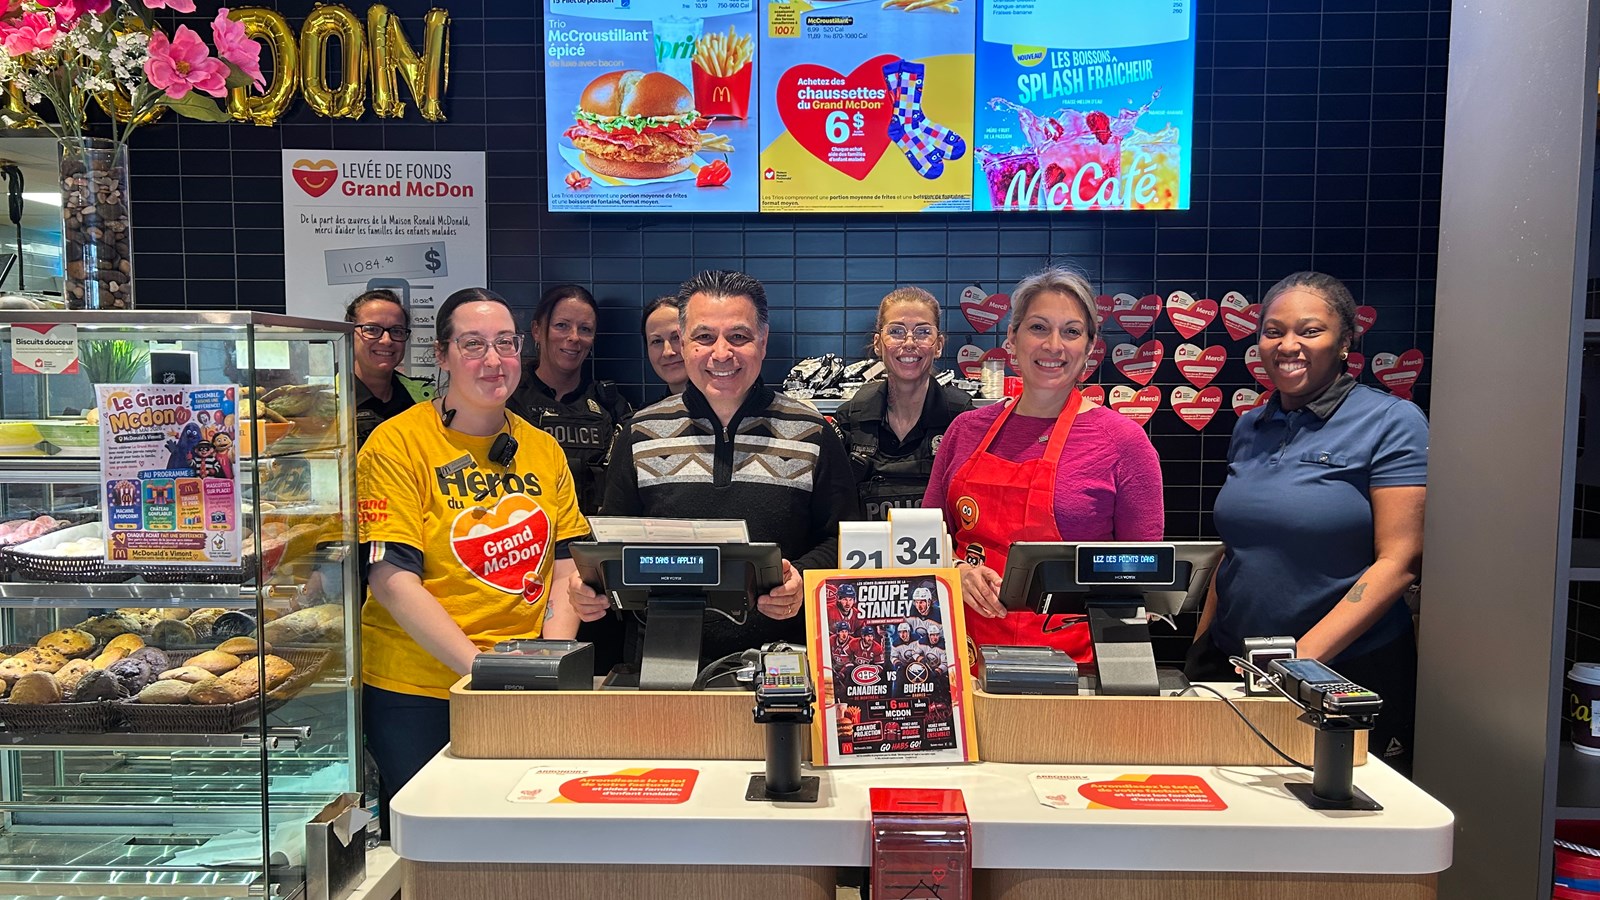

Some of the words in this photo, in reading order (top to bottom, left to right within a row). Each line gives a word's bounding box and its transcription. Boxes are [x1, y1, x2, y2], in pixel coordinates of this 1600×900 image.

[548, 20, 566, 28] Trio
[775, 26, 789, 34] 100
[548, 29, 648, 42] McCroustillant
[548, 43, 585, 59] épicé
[1017, 52, 1042, 61] NOUVEAU!
[1051, 52, 1071, 69] LES
[1073, 50, 1111, 66] BOISSONS
[1017, 65, 1084, 104] SPLASH
[1088, 56, 1153, 91] FRAÎCHEUR
[798, 87, 885, 99] chaussettes
[798, 100, 810, 109] du
[812, 100, 843, 109] Grand
[846, 100, 881, 109] McDon
[825, 110, 850, 144] 6
[853, 111, 864, 130] $
[343, 160, 381, 178] LEVÉE
[385, 164, 403, 178] DE
[407, 164, 452, 179] FONDS
[342, 180, 401, 197] Grand
[406, 182, 474, 197] McDon
[1003, 153, 1157, 210] McCafé
[300, 214, 309, 224] De
[311, 214, 317, 224] la
[319, 215, 333, 227] part
[336, 215, 346, 224] des
[372, 215, 379, 225] de
[381, 216, 387, 225] la
[389, 215, 411, 225] Maison
[414, 215, 435, 226] Ronald
[438, 216, 470, 227] McDonald,
[335, 225, 356, 234] d'aider
[358, 226, 366, 234] les
[368, 226, 392, 235] familles
[395, 226, 405, 235] des
[406, 226, 430, 235] enfants
[432, 226, 456, 236] malades
[425, 247, 441, 273] $
[989, 301, 1008, 311] Merci!
[1196, 307, 1215, 316] Merci!
[1402, 358, 1422, 367] Merci!
[113, 397, 133, 412] Le
[136, 391, 183, 408] Grand
[109, 407, 176, 434] Mcdon
[544, 426, 600, 444] POLICE
[435, 460, 542, 498] Héros
[448, 497, 464, 509] du
[483, 525, 534, 558] Grand
[896, 537, 940, 565] 34
[484, 543, 541, 576] McDon
[846, 550, 882, 569] 21
[858, 584, 909, 602] COUPE
[857, 600, 913, 619] STANLEY
[887, 671, 896, 681] VS
[847, 685, 887, 696] CANADIENS
[904, 683, 934, 693] BUFFALO
[890, 700, 897, 709] 6
[885, 709, 911, 718] MCDON
[892, 742, 908, 750] HABS
